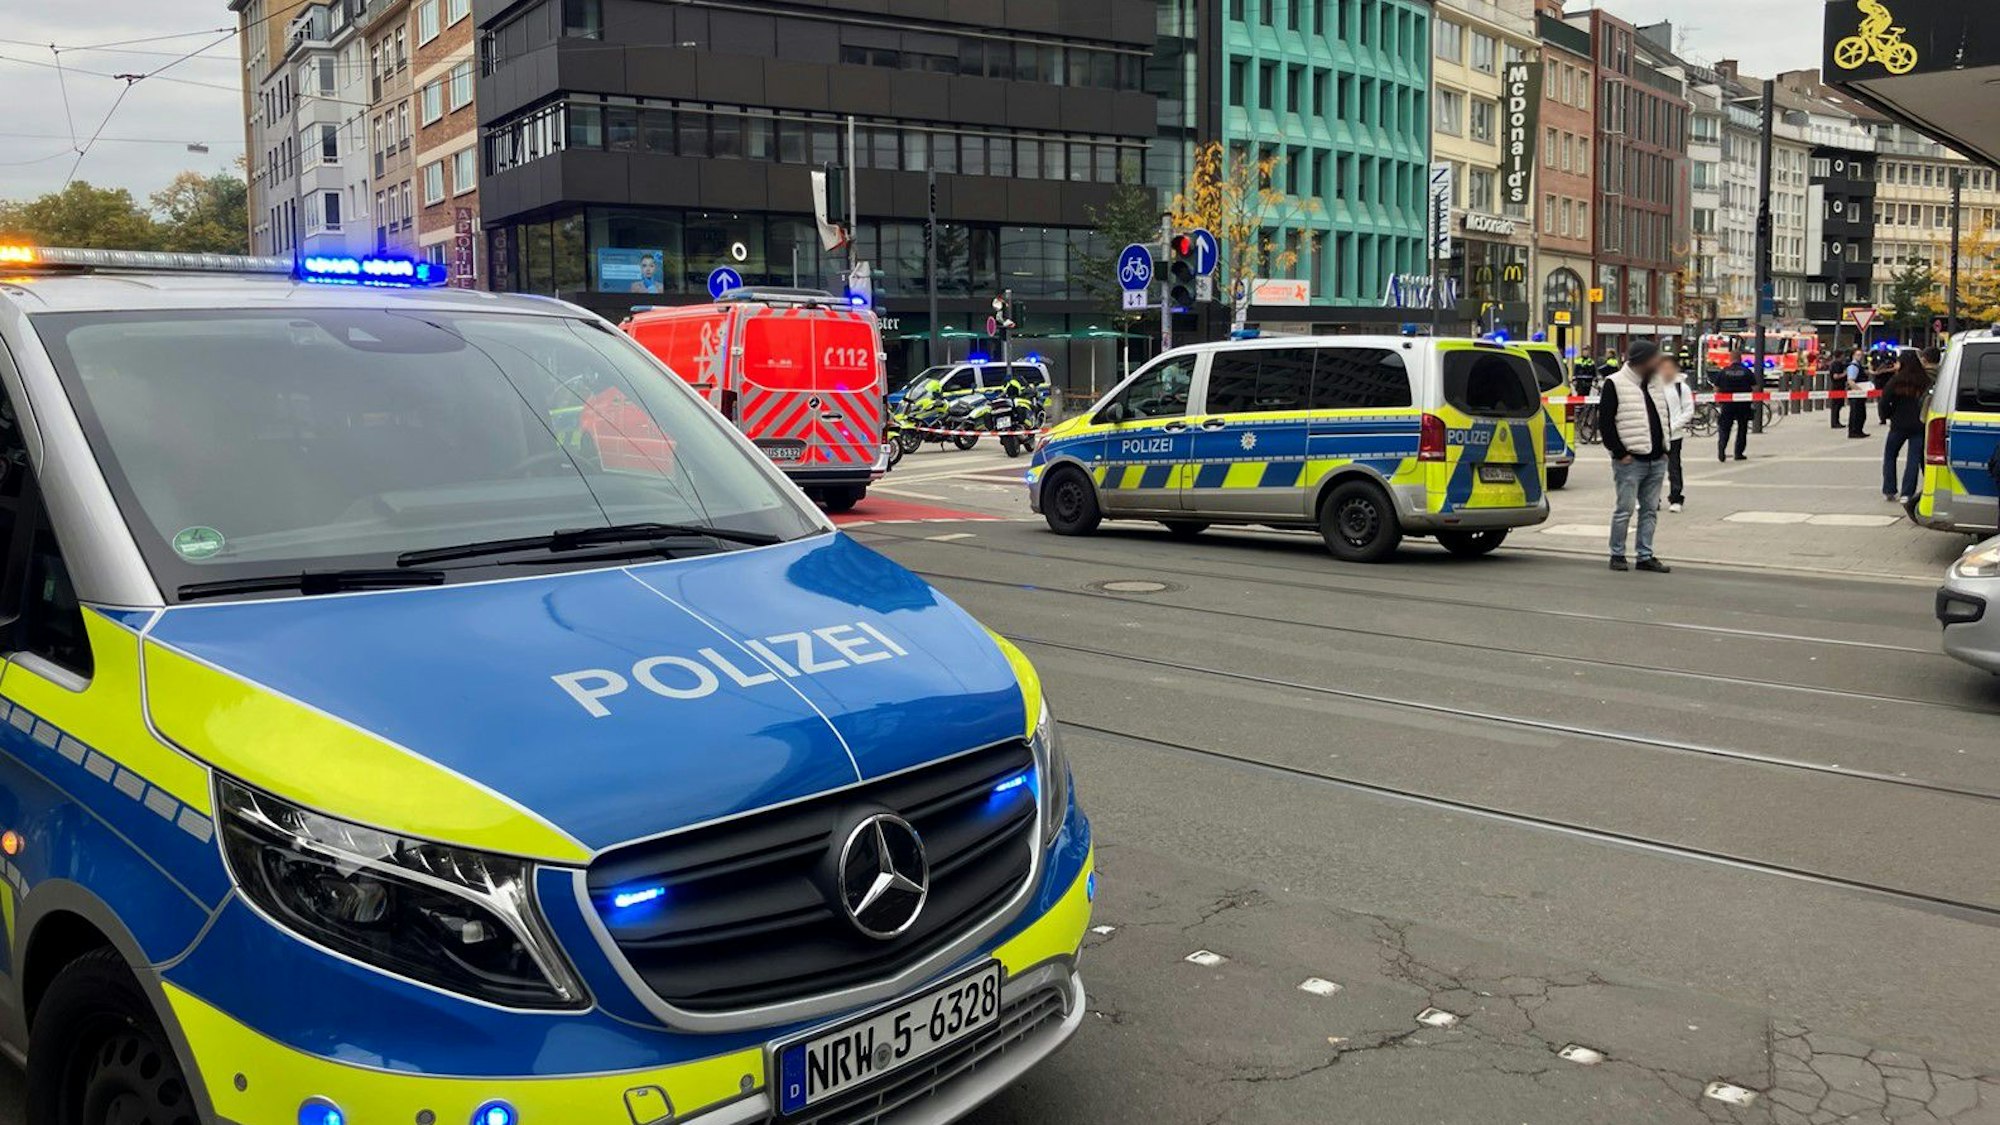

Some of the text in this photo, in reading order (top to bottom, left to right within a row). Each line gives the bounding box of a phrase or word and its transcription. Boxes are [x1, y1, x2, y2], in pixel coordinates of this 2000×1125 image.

[1508, 65, 1527, 202] McDonald's
[1466, 212, 1516, 235] McDonald's
[836, 347, 868, 367] 112
[1121, 438, 1173, 453] POLIZEI
[1446, 429, 1491, 445] POLIZEI
[551, 621, 909, 718] POLIZEI
[789, 974, 996, 1099] D NRW 5-6328
